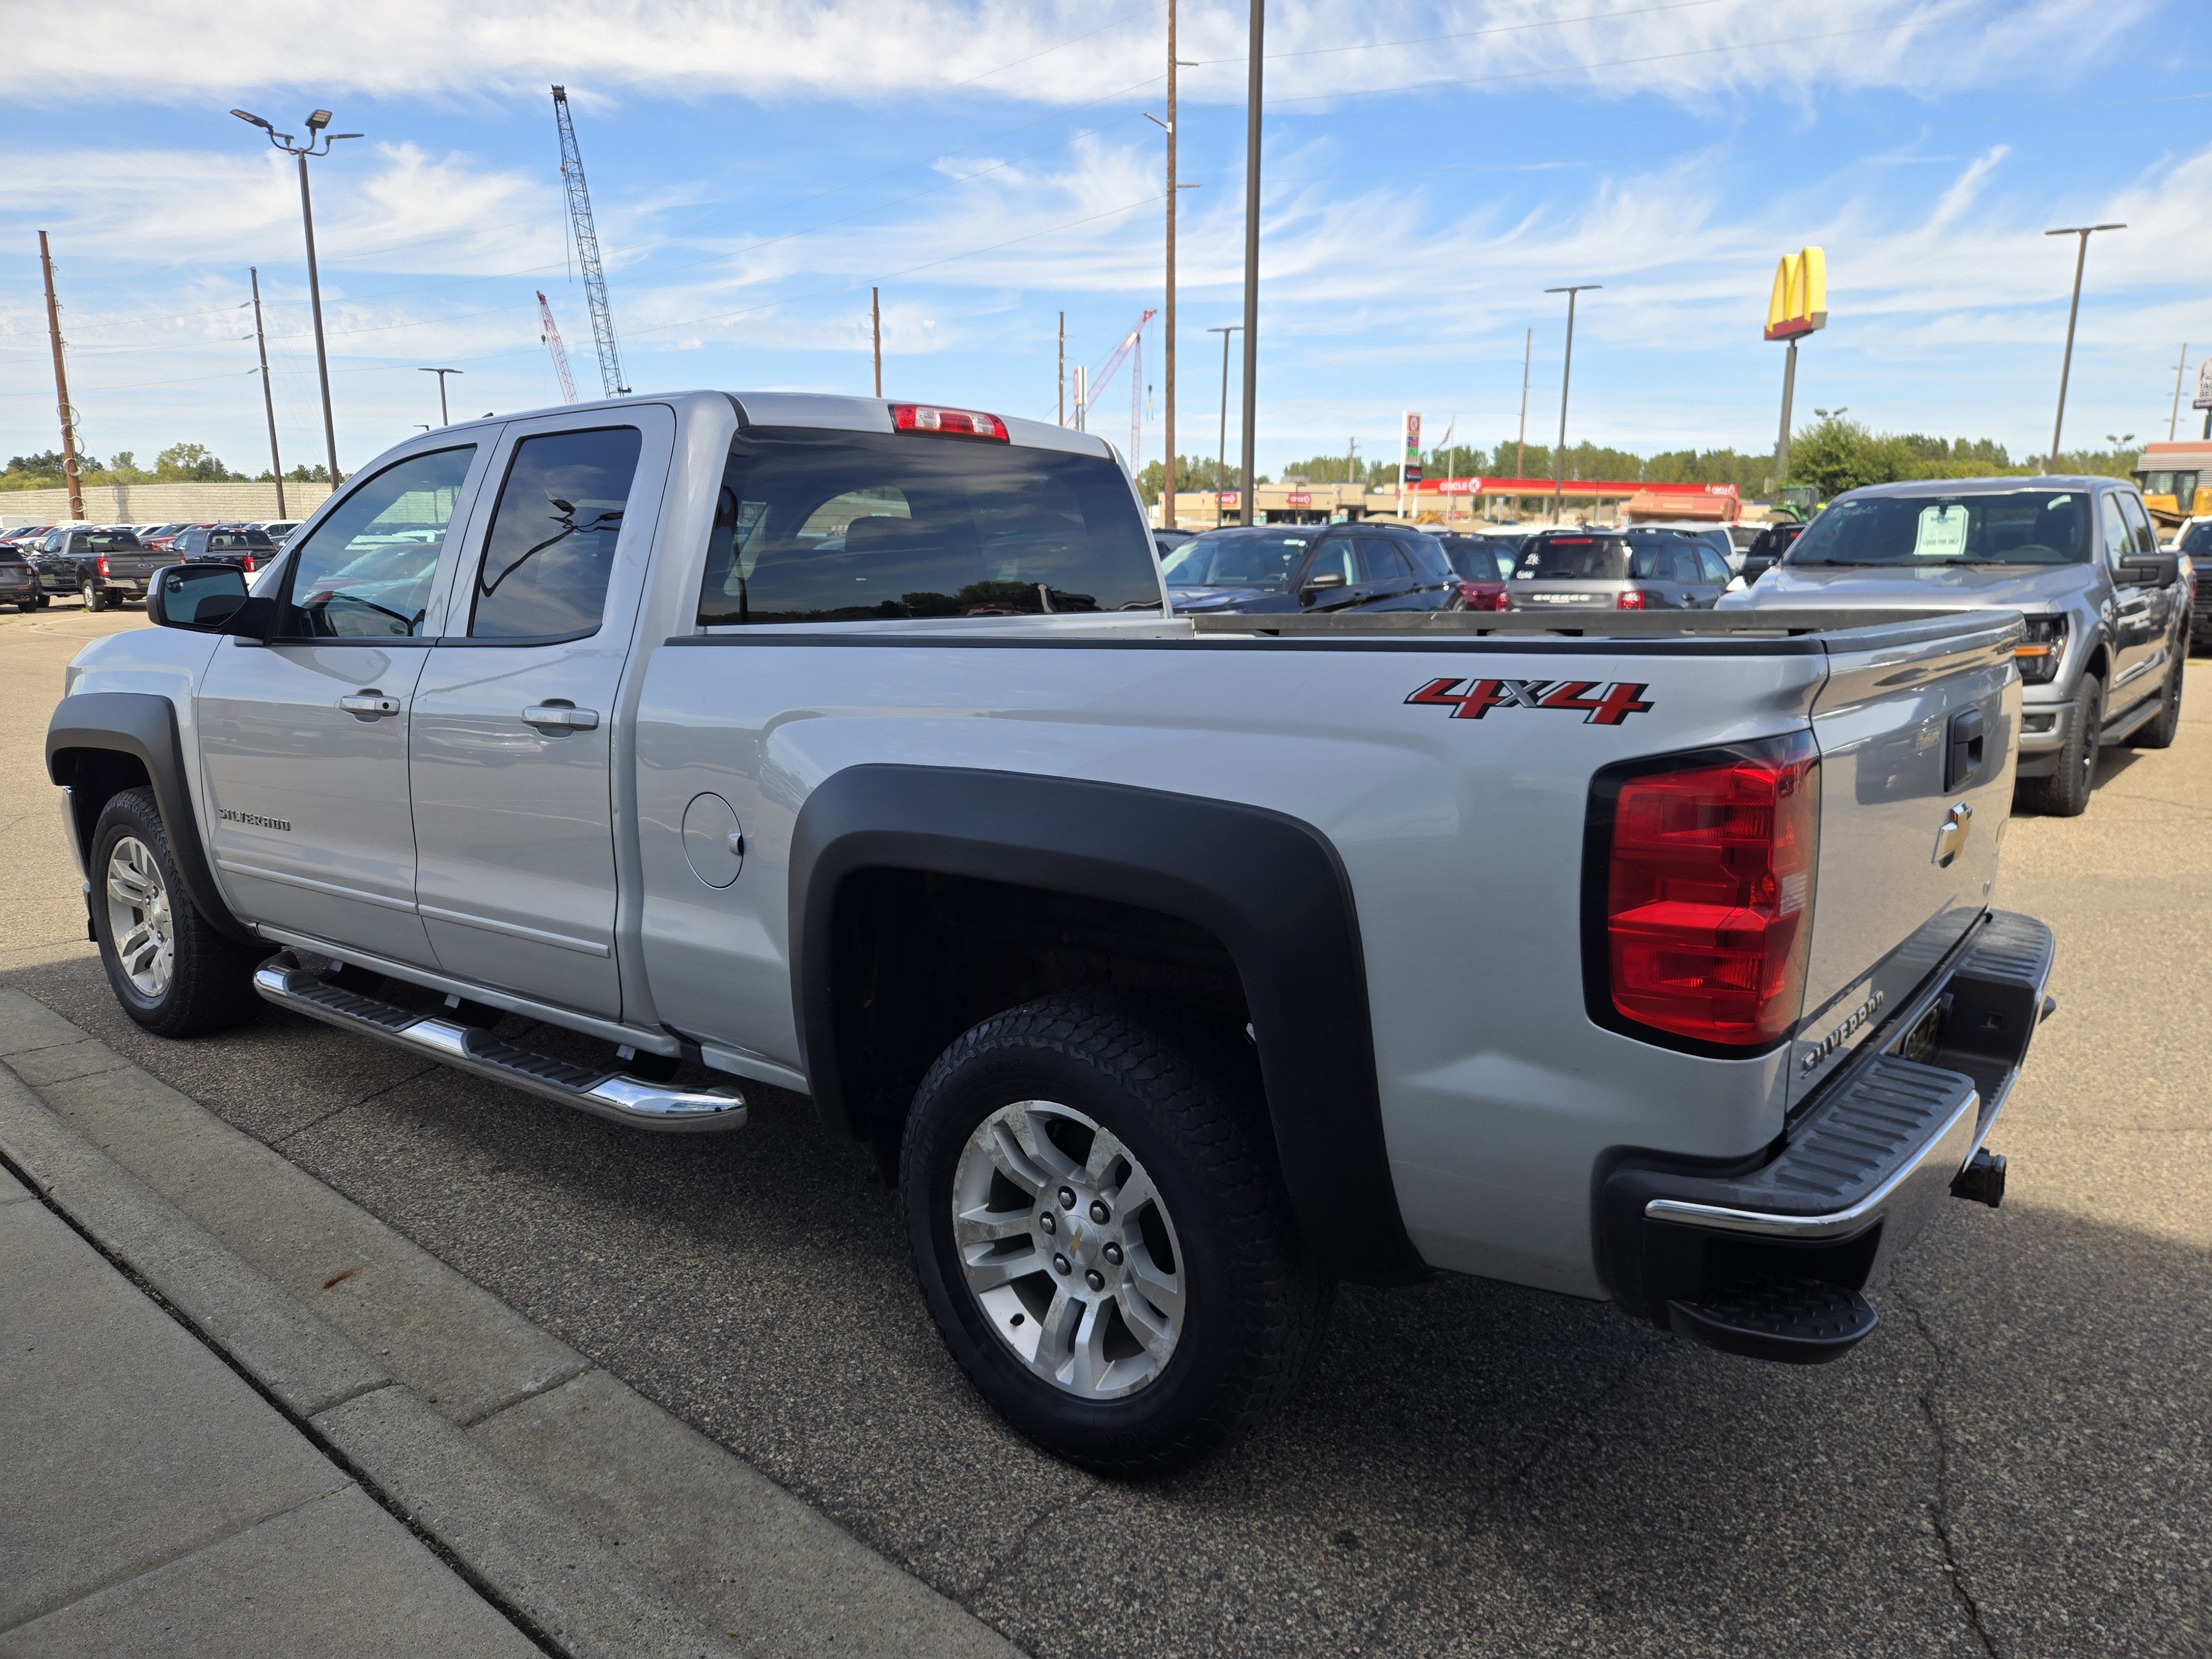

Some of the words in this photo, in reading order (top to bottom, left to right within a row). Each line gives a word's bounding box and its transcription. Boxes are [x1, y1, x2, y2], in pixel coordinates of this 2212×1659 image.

[1439, 481, 1468, 492] CIRCLE
[1468, 477, 1481, 493] K
[218, 807, 291, 832] SILVERADO
